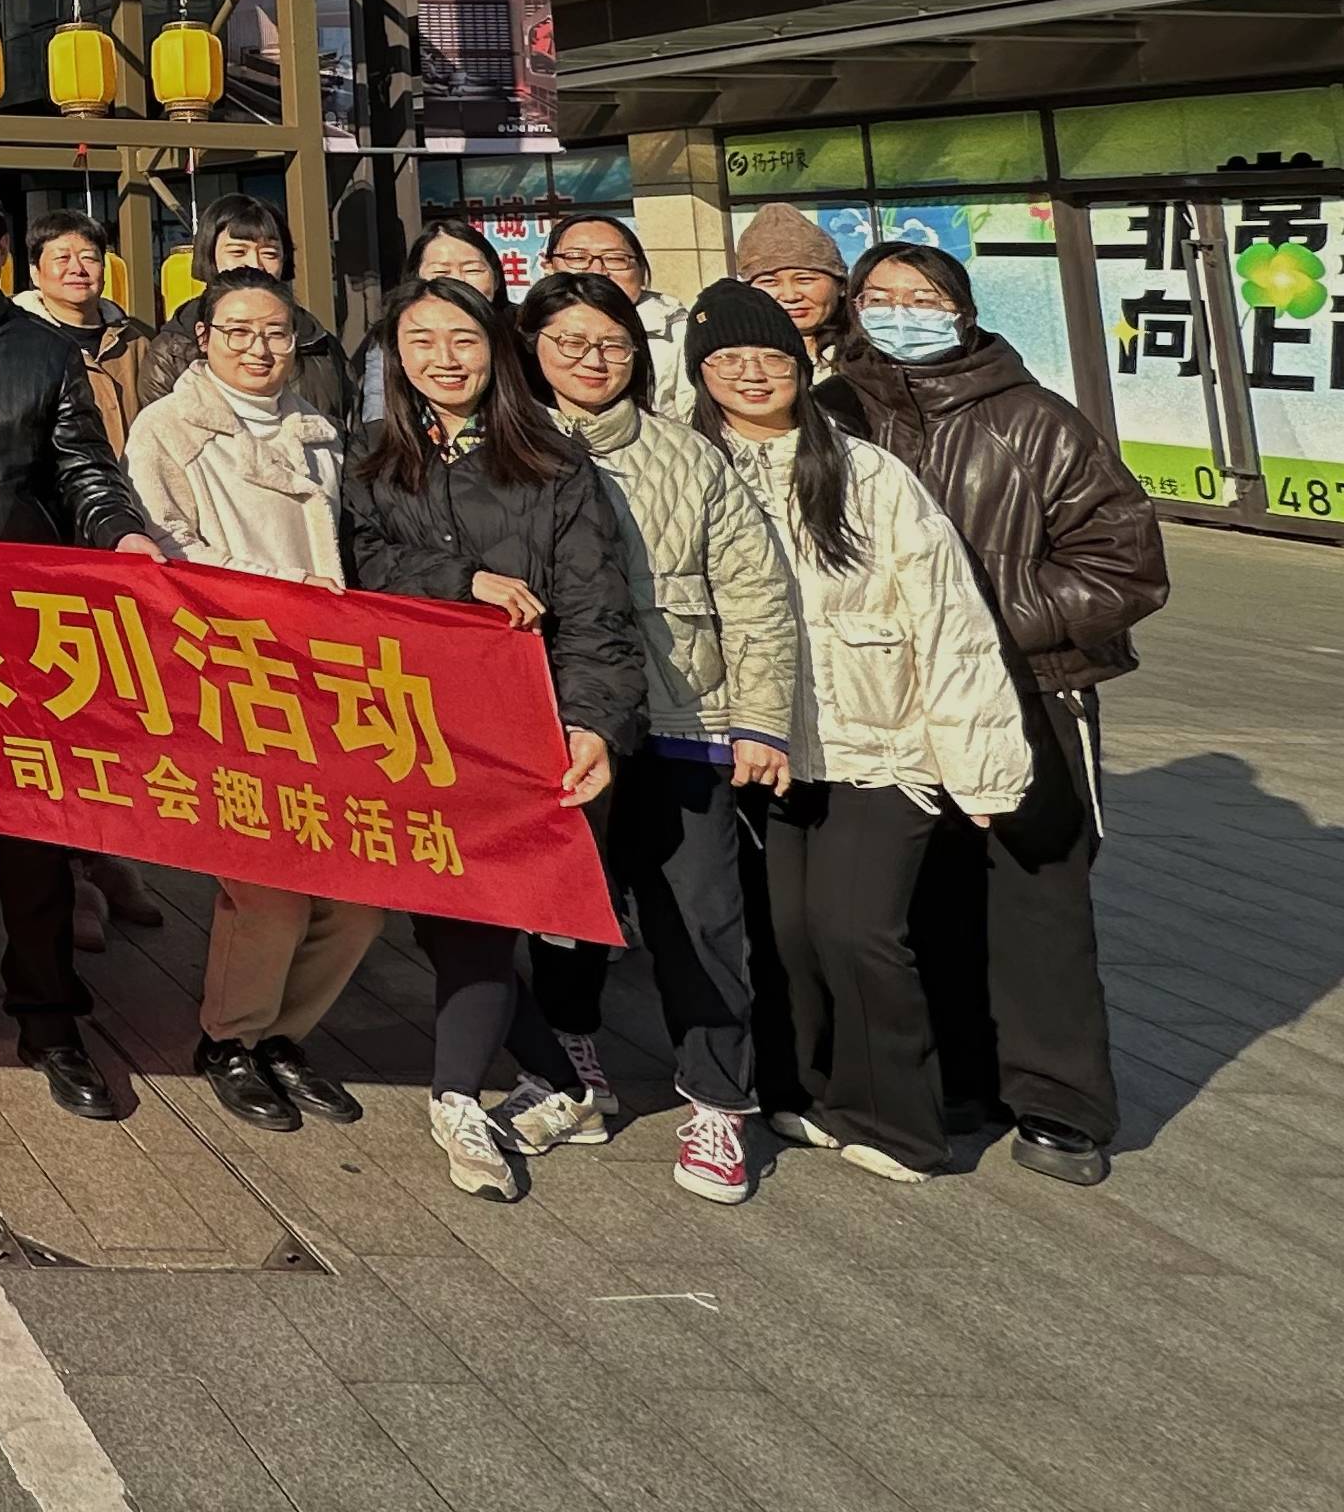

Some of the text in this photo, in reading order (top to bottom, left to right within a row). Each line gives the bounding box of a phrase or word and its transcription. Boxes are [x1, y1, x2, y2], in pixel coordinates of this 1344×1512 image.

[752, 148, 809, 172] 扬子印象
[1118, 289, 1344, 393] 向上
